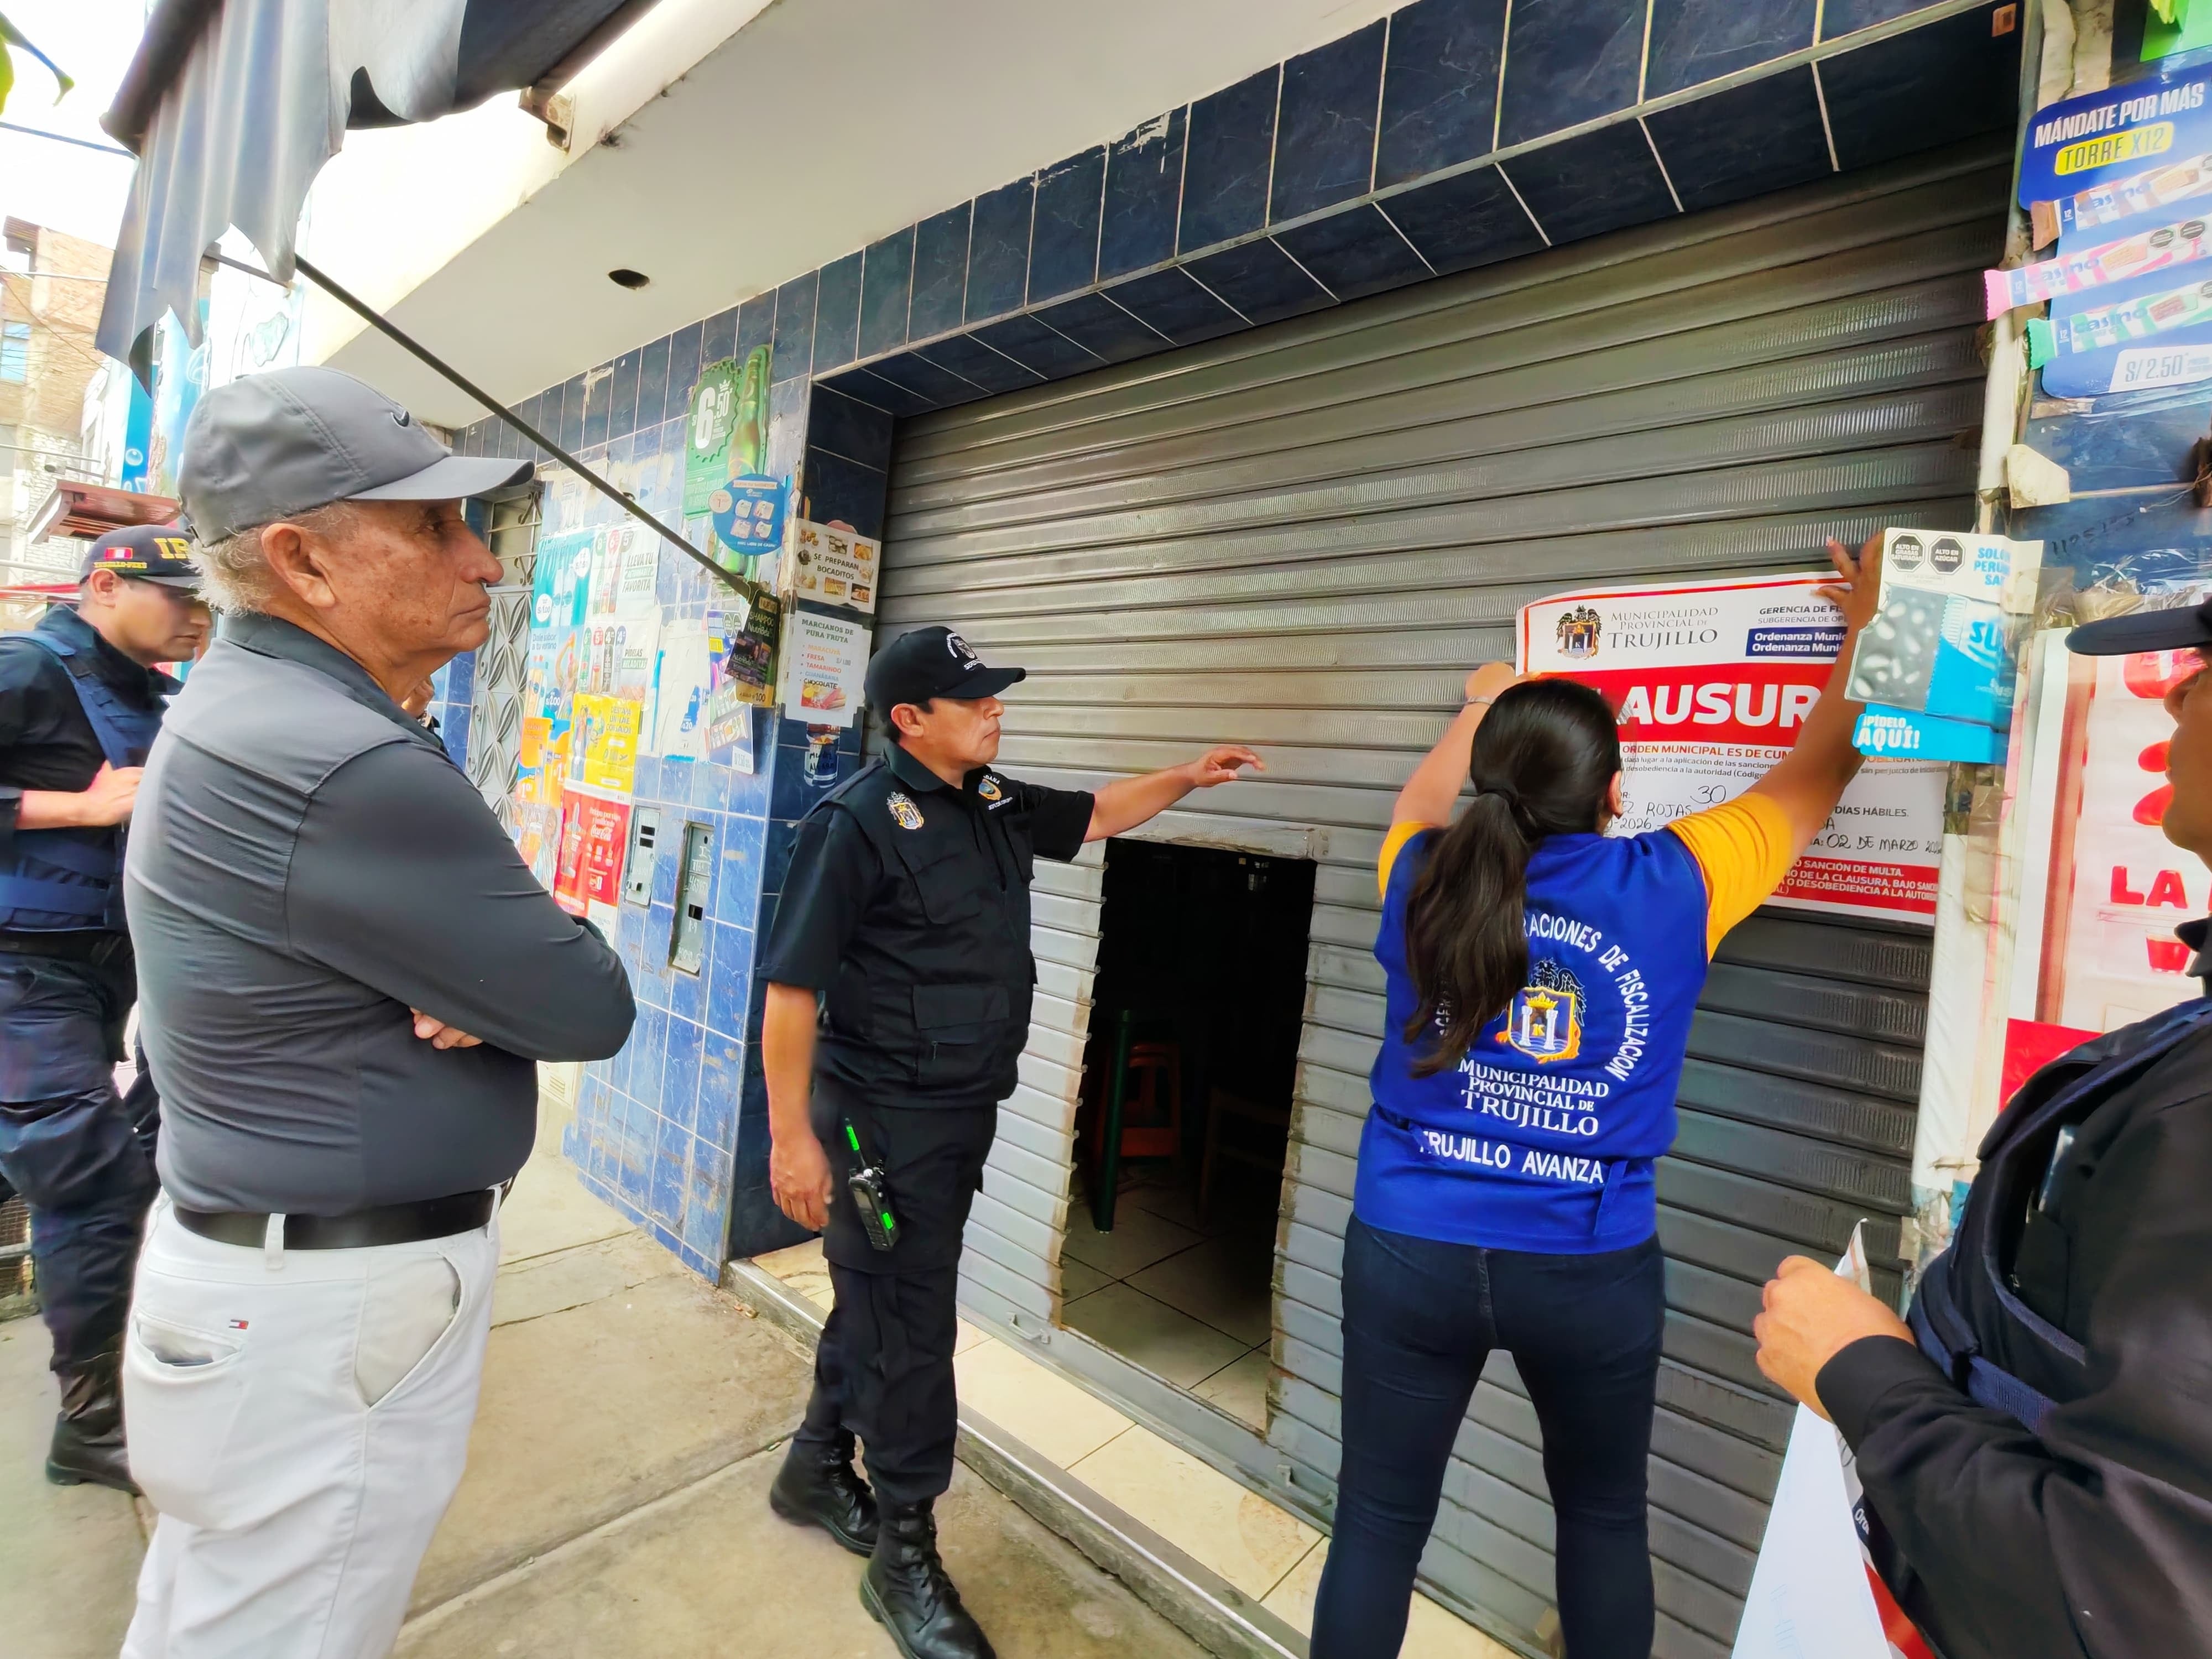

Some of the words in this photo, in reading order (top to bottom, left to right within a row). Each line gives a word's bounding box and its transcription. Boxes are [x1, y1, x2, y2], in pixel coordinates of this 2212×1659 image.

[2034, 105, 2119, 148] MÁNDATE
[2119, 98, 2158, 126] POR
[2159, 82, 2204, 116] MÁS
[2064, 136, 2124, 171] TORRE
[2130, 127, 2165, 155] X12
[627, 554, 644, 567] LLEVA
[645, 552, 654, 565] TU
[825, 556, 859, 570] PREPARAN
[817, 565, 854, 580] BOCADITOS
[622, 579, 650, 593] FAVORITA
[1611, 607, 1718, 622] MUNICIPALIDAD
[1760, 606, 1810, 614] GERENCIA
[801, 619, 843, 633] MARCIANOS
[1620, 619, 1694, 630] PROVINCIAL
[1757, 616, 1815, 624] SUBGERENCIA
[806, 629, 825, 639] PURA
[826, 634, 848, 643] FRUTA
[1608, 629, 1718, 650] TRUJILLO
[1755, 633, 1813, 641] Ordenanza
[1752, 643, 1810, 652] Ordenanza
[1812, 644, 1841, 652] Muni
[807, 662, 842, 674] TAMARINDO
[804, 678, 838, 690] CHOCOLATE
[1857, 725, 1921, 752] AQUÍ!
[1662, 745, 1724, 756] MUNICIPAL
[1727, 748, 1742, 757] ES
[1745, 749, 1761, 758] DE
[1674, 757, 1712, 765] aplicación
[1694, 768, 1731, 776] autoridad
[1690, 785, 1726, 804] 30
[1646, 801, 1692, 817] ROJAS
[1834, 806, 1860, 815] DÍAS
[1863, 807, 1909, 817] HÁBILES.
[1827, 833, 1851, 849] 02
[1856, 836, 1874, 849] DE
[1879, 839, 1918, 852] MARZO
[1804, 860, 1851, 872] SANCIÓN
[1853, 864, 1867, 873] DE
[1800, 870, 1814, 879] DE
[1816, 872, 1829, 880] LA
[1892, 880, 1916, 889] BAJO
[1797, 880, 1880, 895] DESOBEDIENCIA
[1891, 889, 1903, 898] LA
[1598, 943, 1629, 974] DE
[1604, 969, 1650, 1083] FISCALIZACION
[1458, 1058, 1610, 1098] MUNICIPALIDAD
[1468, 1076, 1575, 1111] PROVINCIAL
[1578, 1099, 1595, 1112] DE
[1460, 1089, 1599, 1136] TRUJILLO
[1521, 1151, 1604, 1185] AVANZA
